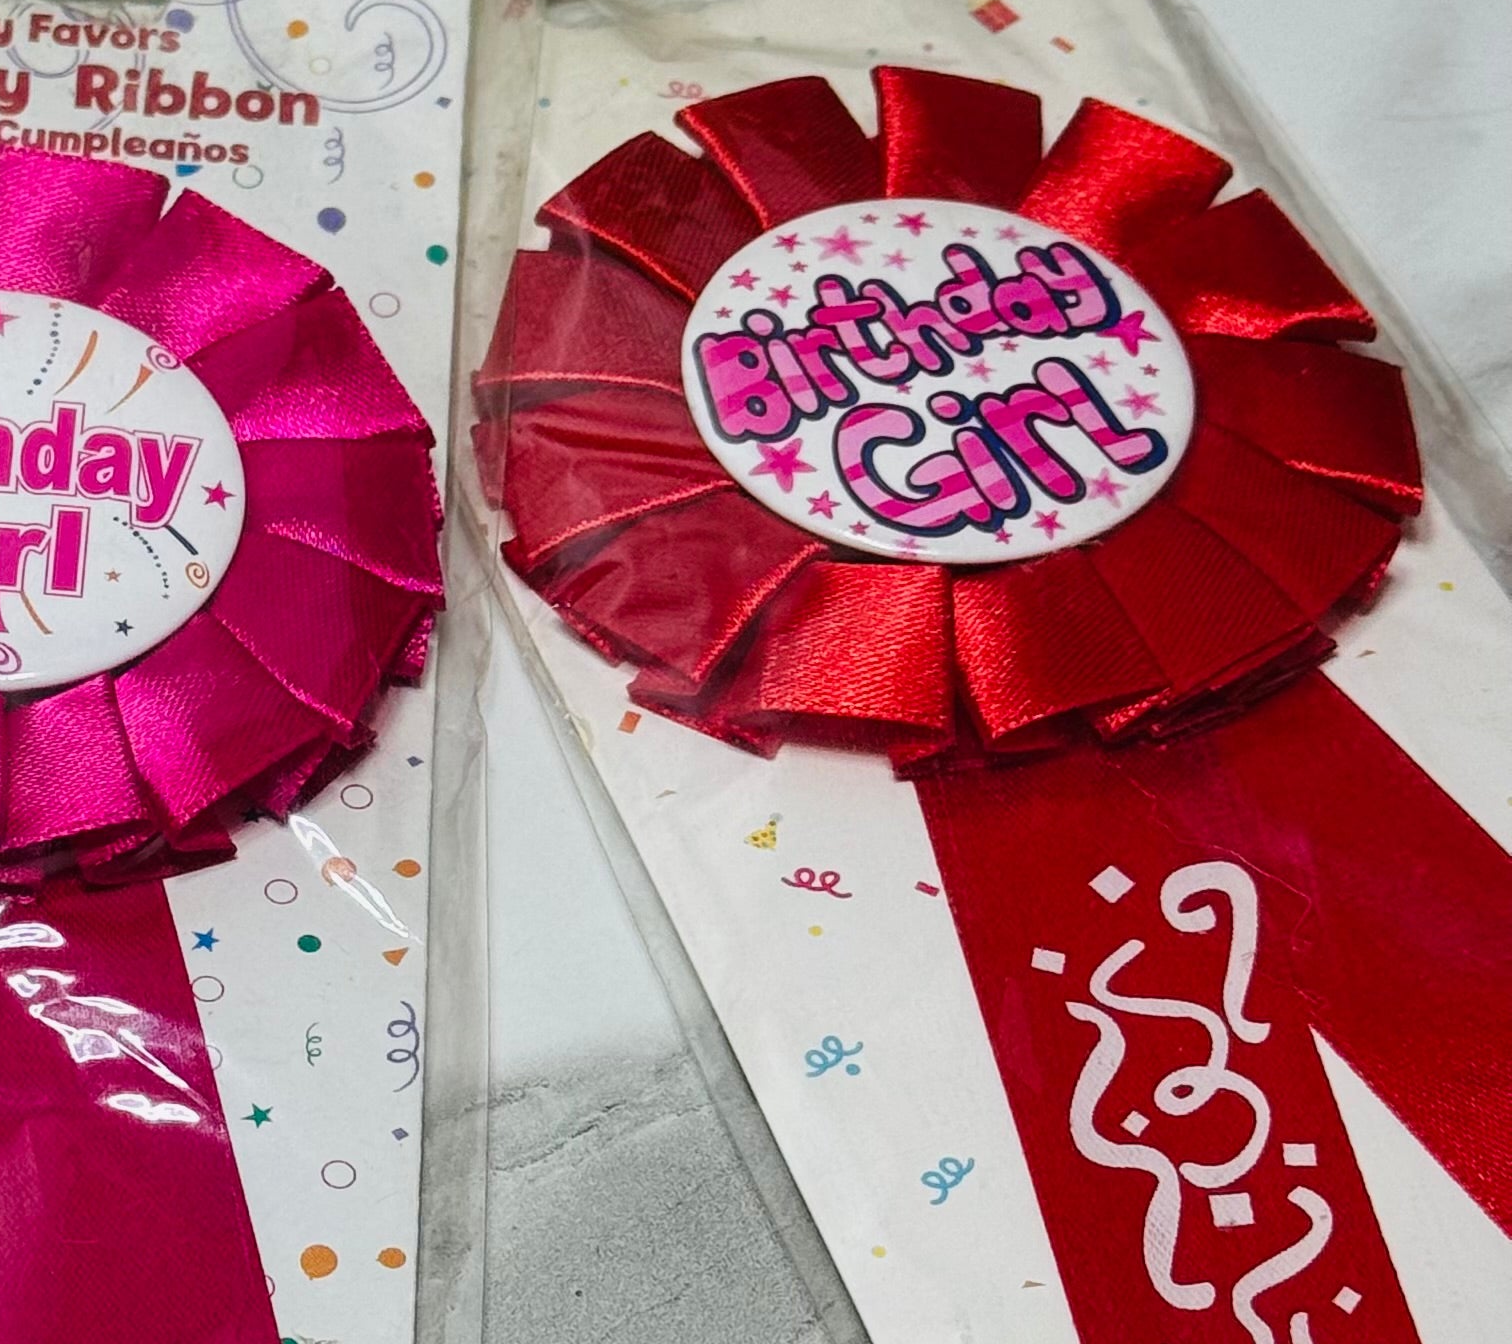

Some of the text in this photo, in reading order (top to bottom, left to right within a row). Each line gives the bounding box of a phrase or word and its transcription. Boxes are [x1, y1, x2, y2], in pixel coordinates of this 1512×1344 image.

[28, 13, 181, 54] Favors
[75, 64, 320, 127] Ribbon
[692, 242, 1122, 443] Birthday
